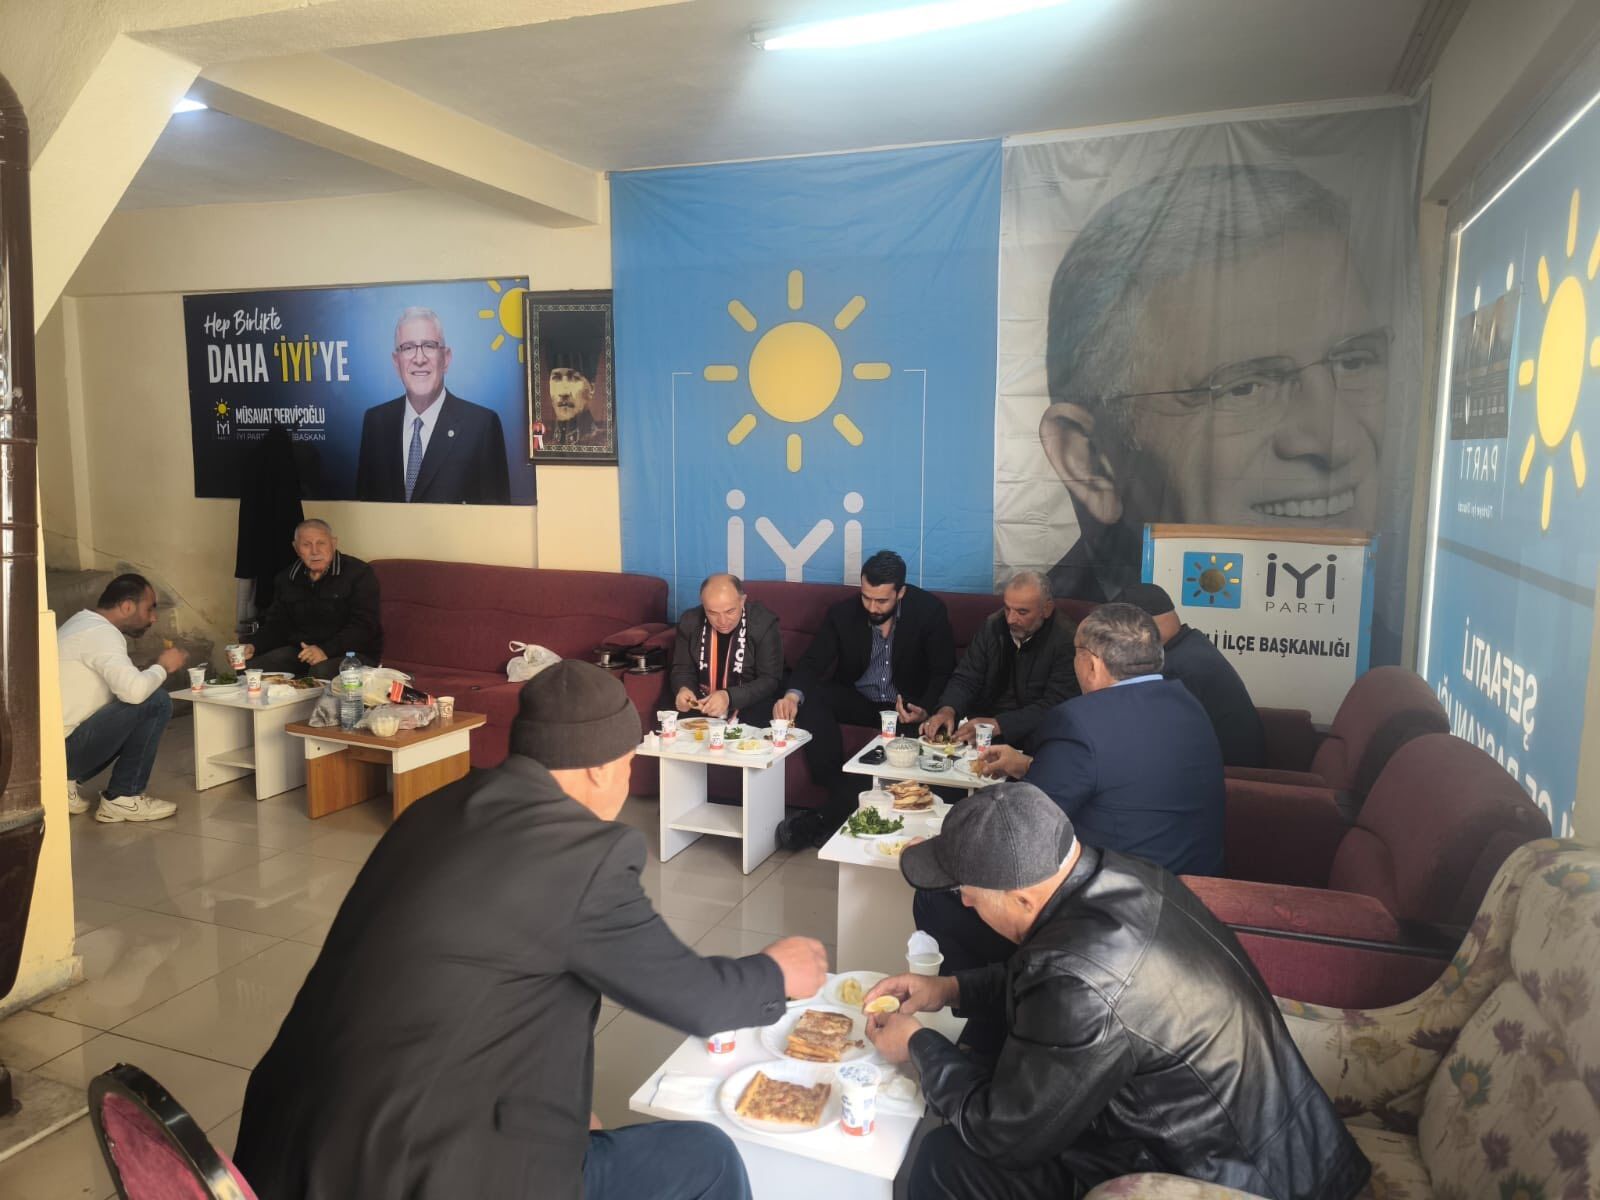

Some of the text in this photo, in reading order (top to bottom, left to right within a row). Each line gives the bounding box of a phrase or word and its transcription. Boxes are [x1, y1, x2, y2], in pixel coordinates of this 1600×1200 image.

[204, 306, 283, 339] Hep Birlikte
[207, 343, 270, 384] DAHA
[216, 420, 230, 435] İYİ
[235, 405, 273, 424] MÜSAVAT
[726, 489, 864, 586] İYİ
[1266, 553, 1337, 600] İYİ
[1265, 601, 1335, 615] PARTİ
[1223, 630, 1255, 655] İLÇE
[1259, 637, 1350, 658] BAŞKANLIĞI
